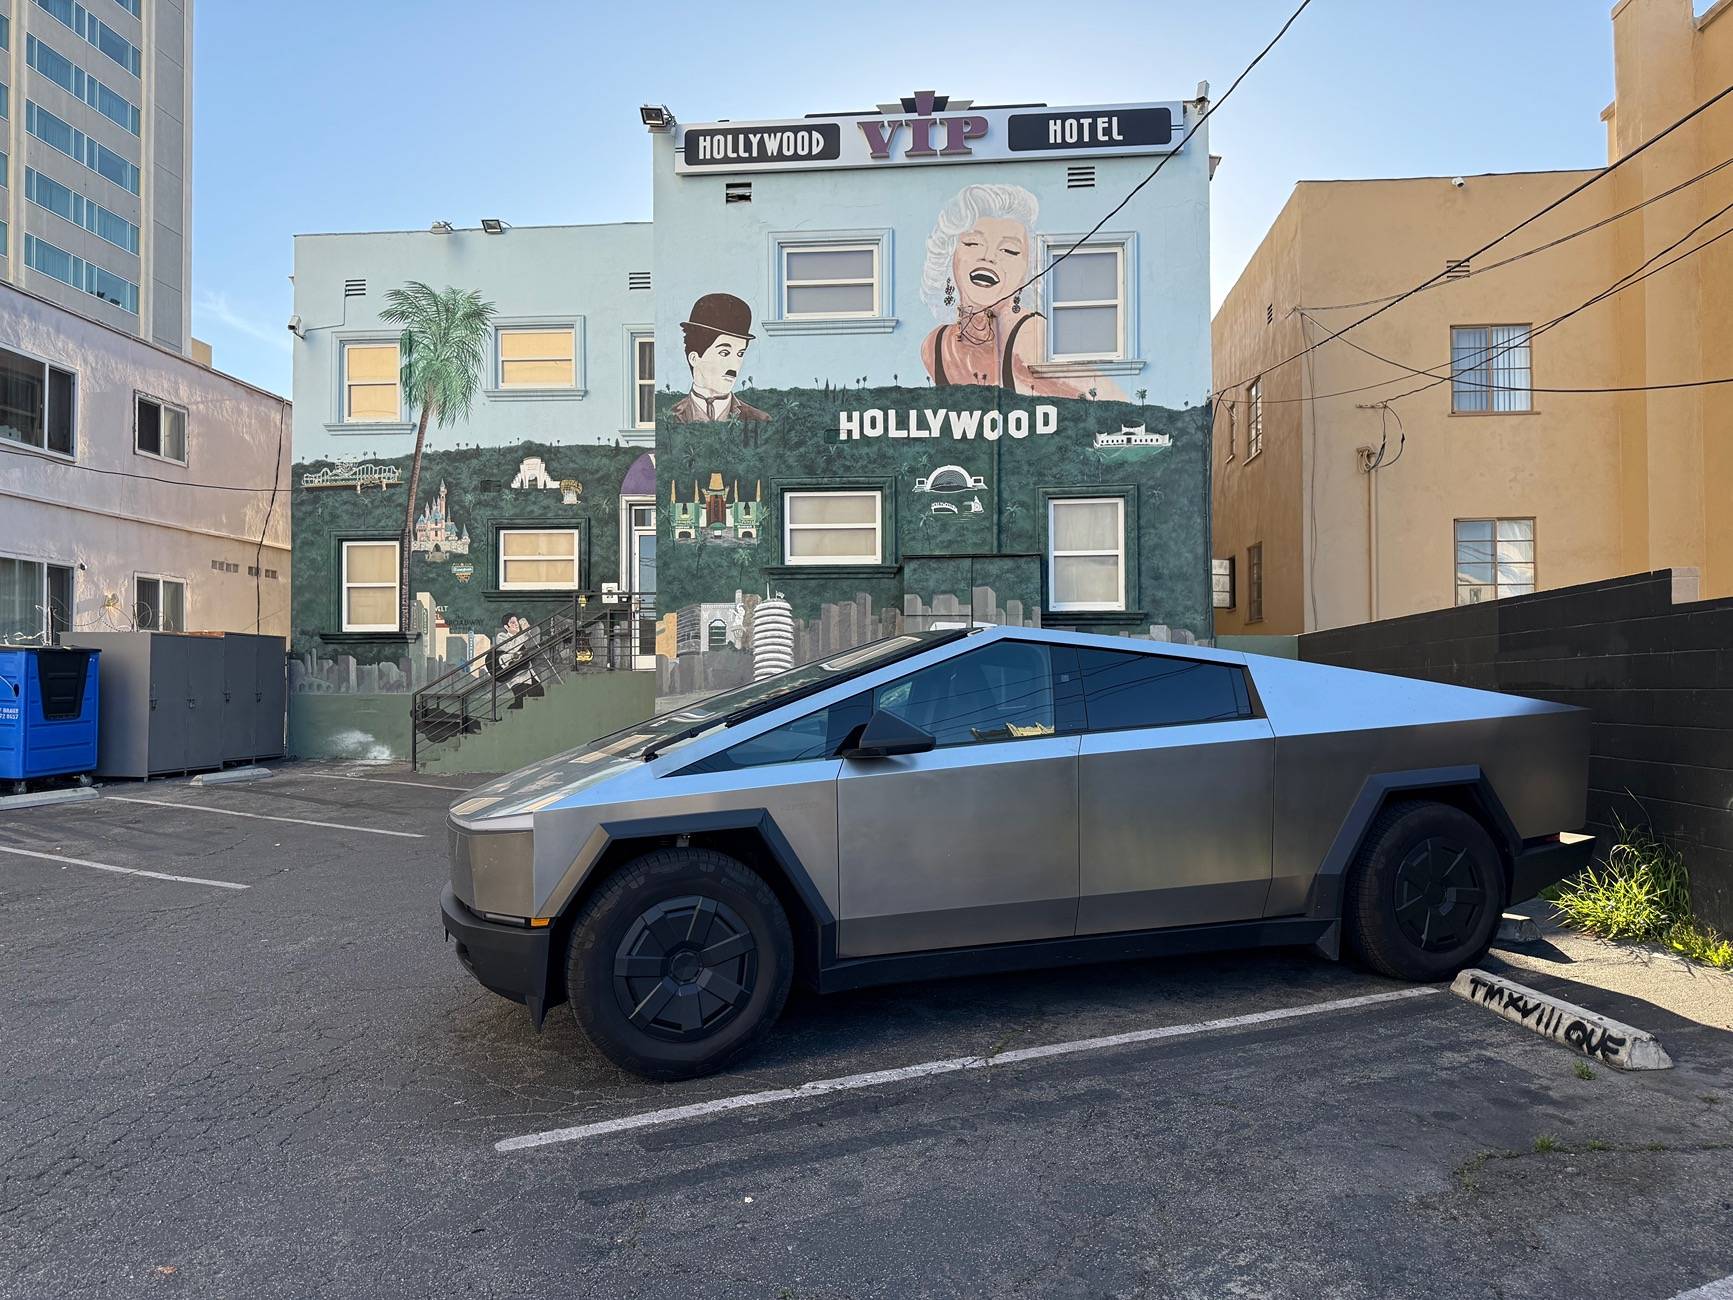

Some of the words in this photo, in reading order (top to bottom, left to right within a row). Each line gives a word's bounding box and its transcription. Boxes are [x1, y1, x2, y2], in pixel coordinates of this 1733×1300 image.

[698, 130, 825, 160] HOLLYWOOD
[857, 115, 989, 158] VIP
[1048, 116, 1124, 144] HOTEL
[839, 404, 1058, 441] HOLLYWOOD
